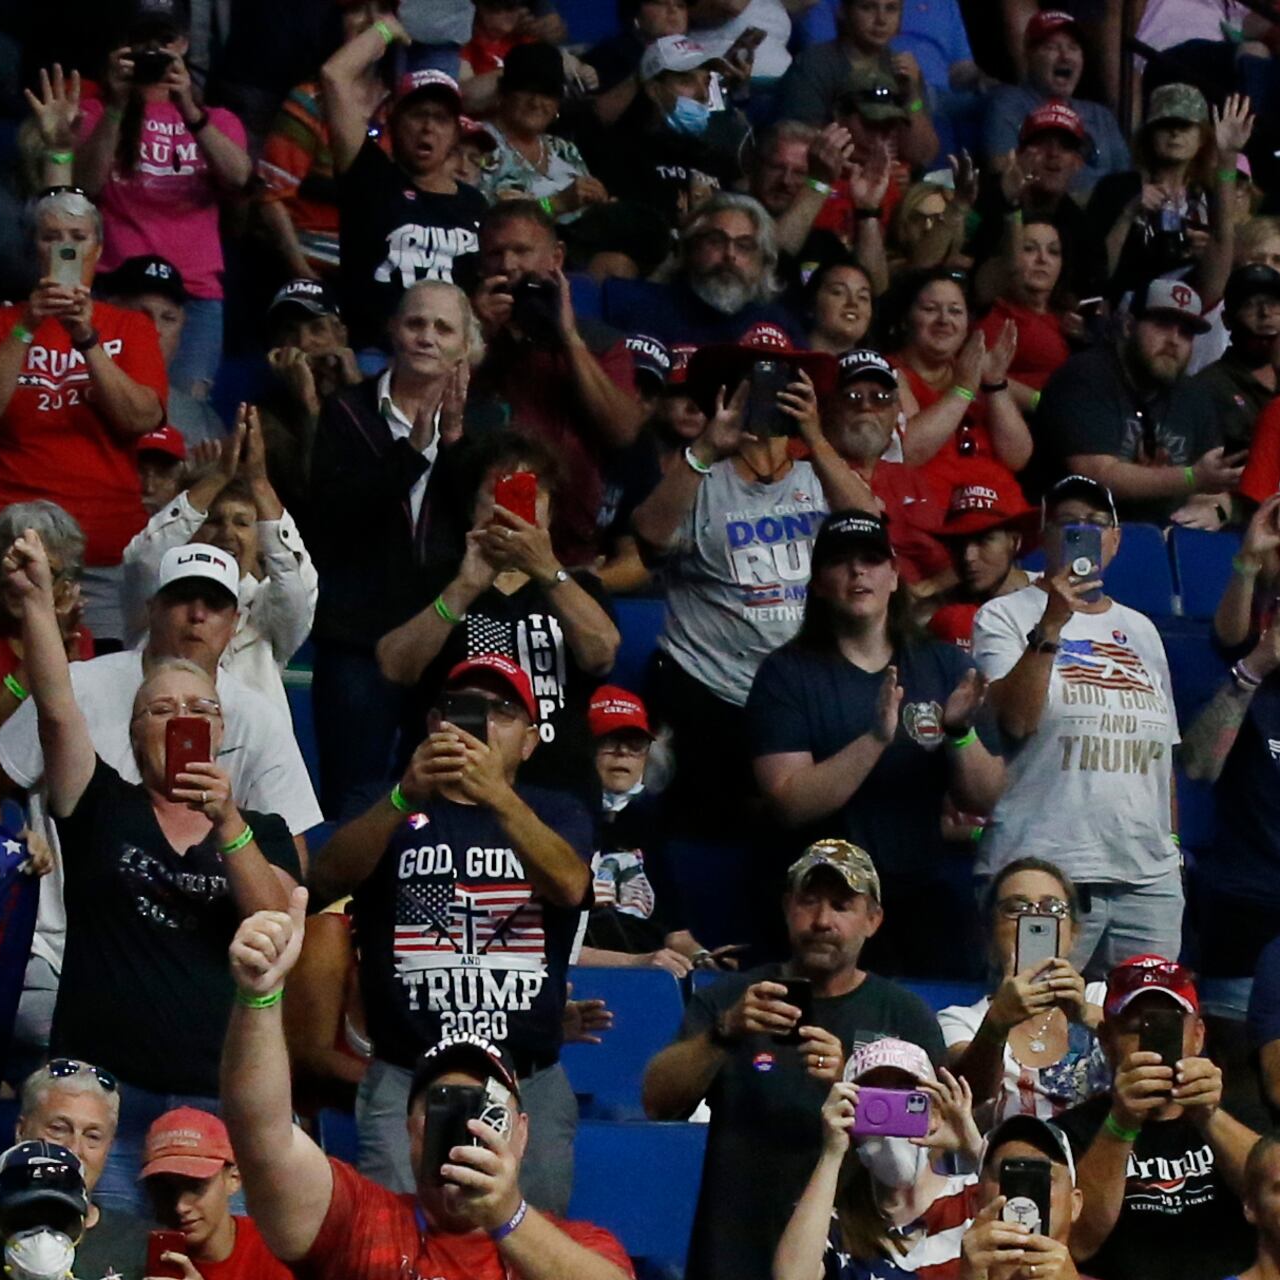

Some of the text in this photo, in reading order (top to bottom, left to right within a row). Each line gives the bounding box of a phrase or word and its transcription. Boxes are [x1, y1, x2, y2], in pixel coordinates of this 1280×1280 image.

[656, 166, 687, 180] TWO
[625, 338, 671, 369] TRUMP
[839, 352, 890, 371] TRUMP
[1099, 712, 1138, 734] AND
[1058, 735, 1166, 776] TRUMP
[398, 844, 455, 880] GOD,
[460, 957, 481, 966] AND
[403, 969, 544, 1012] TRUMP
[441, 1011, 508, 1043] 2020
[424, 1031, 502, 1058] TRUMP
